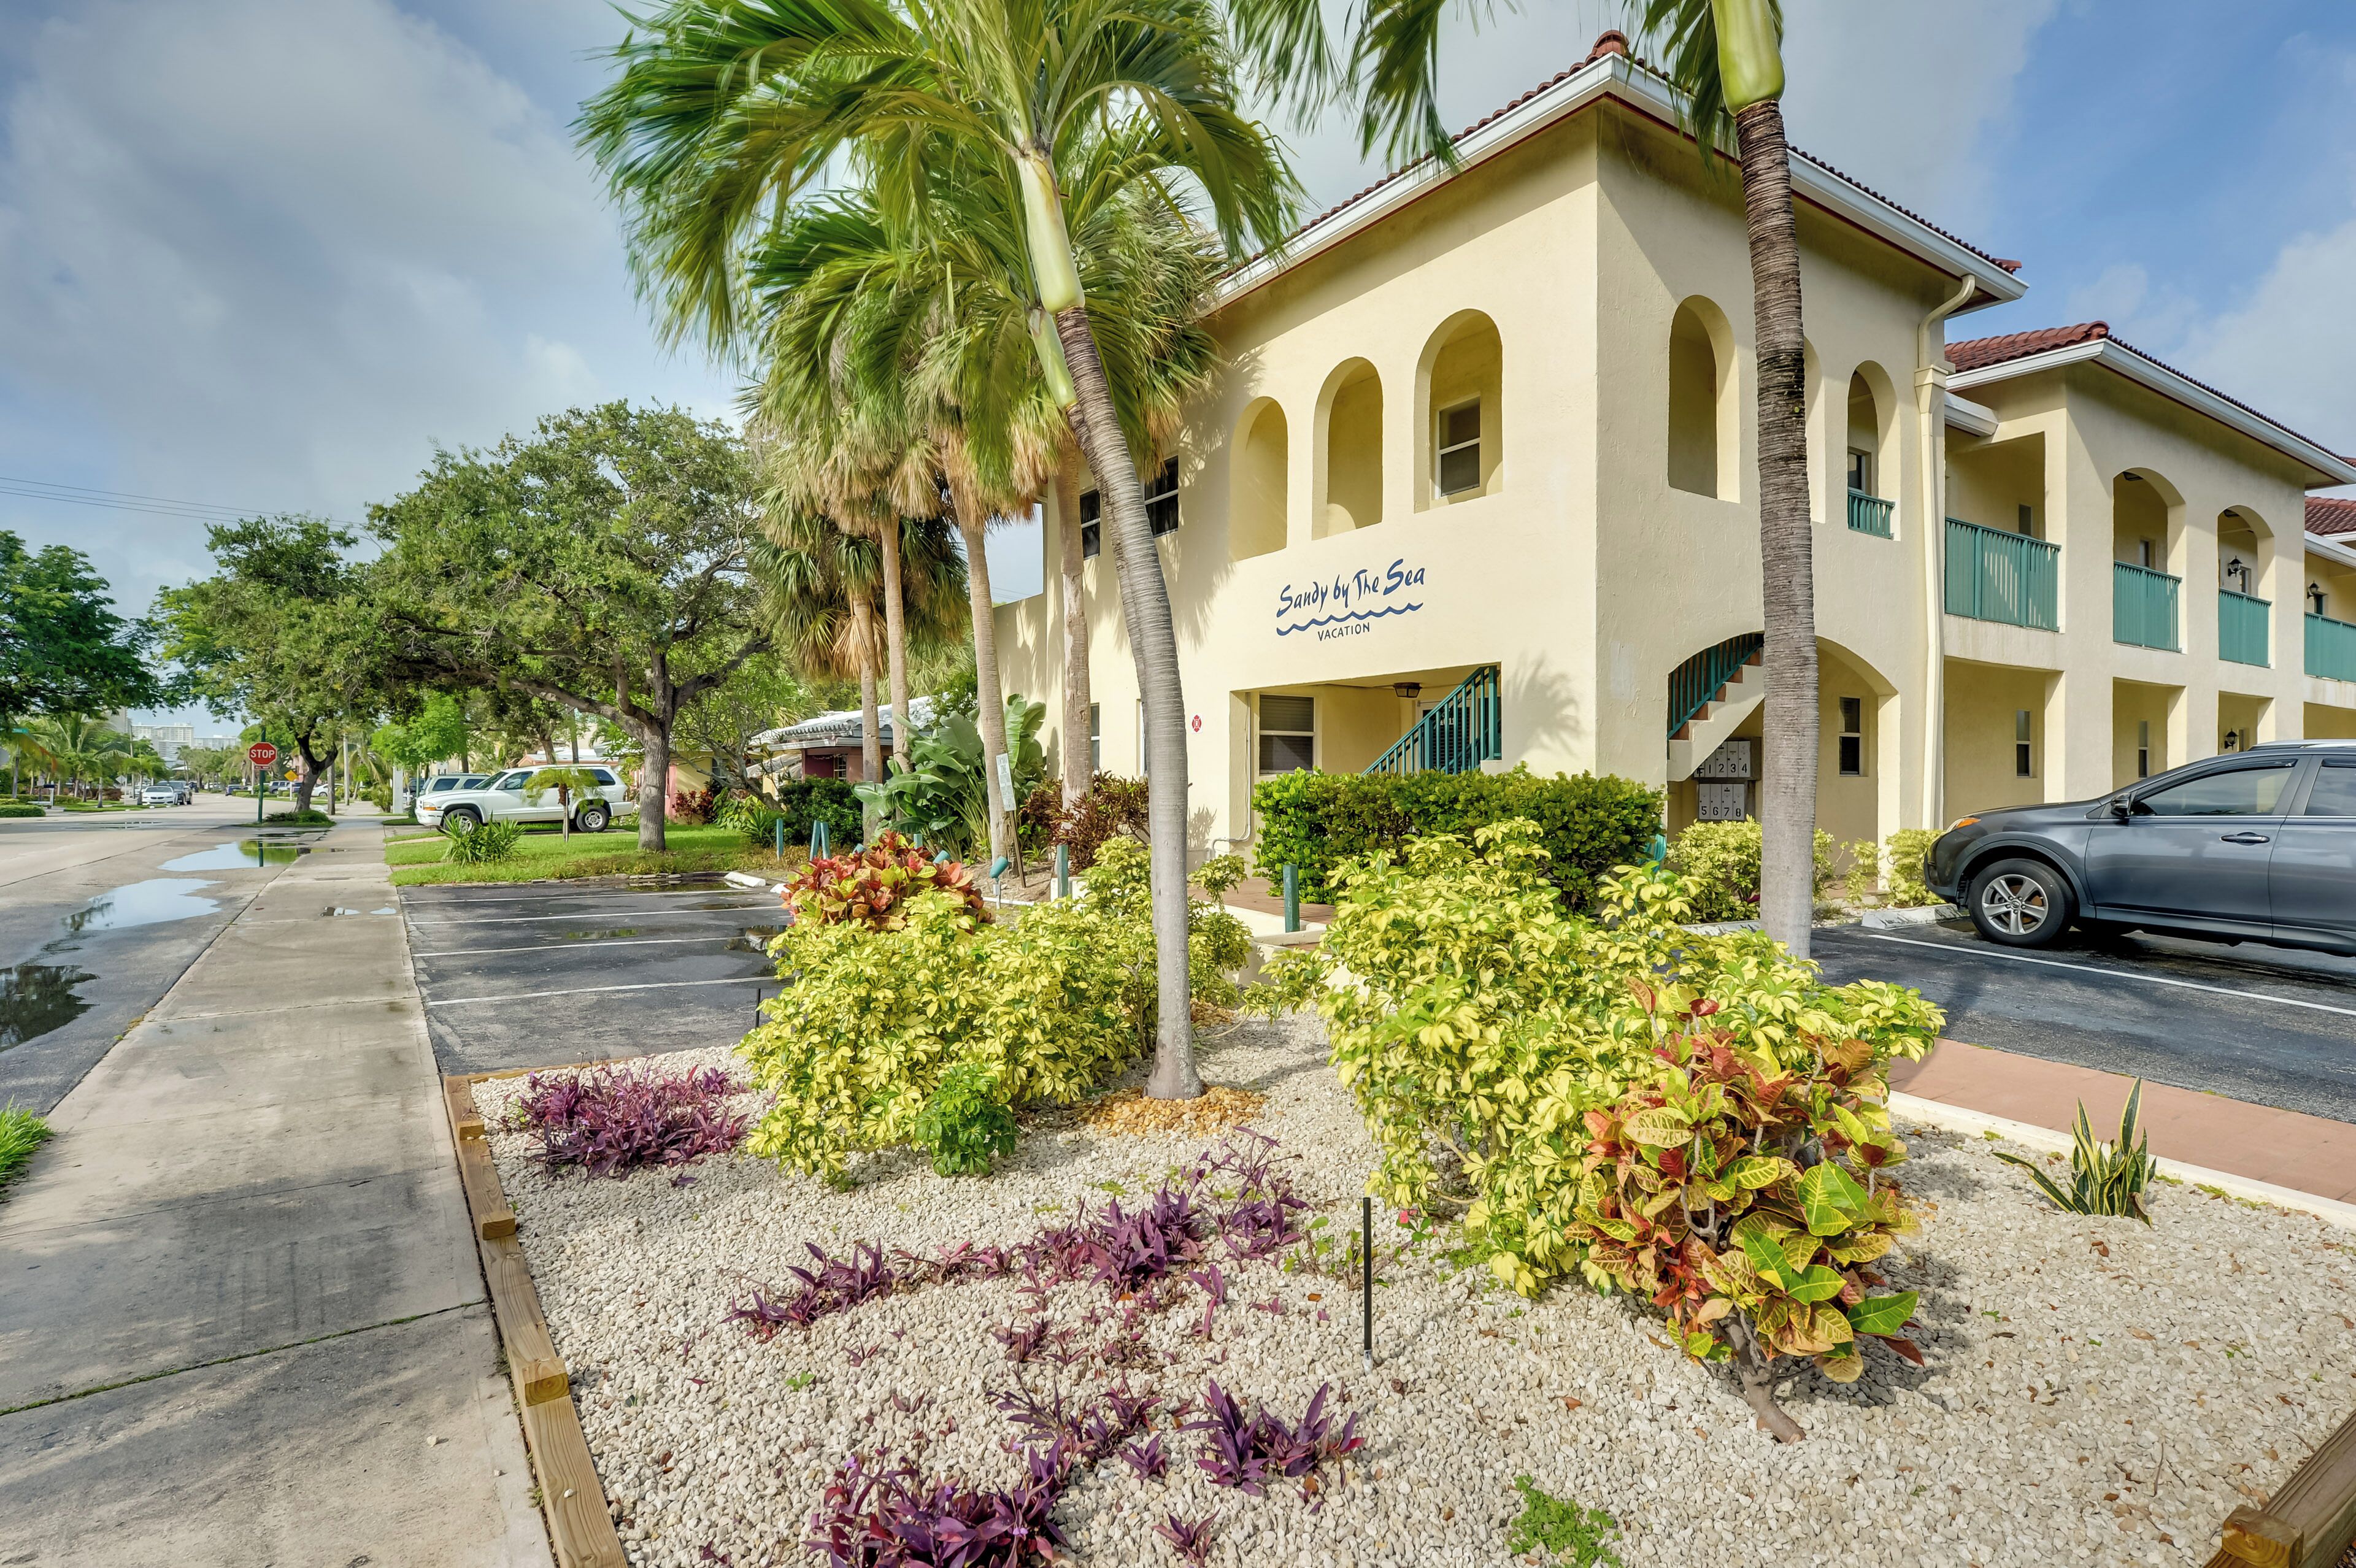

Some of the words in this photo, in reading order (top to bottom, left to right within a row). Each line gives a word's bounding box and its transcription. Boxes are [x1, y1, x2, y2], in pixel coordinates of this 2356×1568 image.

[1276, 581, 1328, 618] Sandy
[1333, 574, 1349, 609] by
[1352, 569, 1379, 601] The
[1383, 558, 1425, 596] Sea
[1317, 622, 1370, 642] VACATION
[250, 749, 275, 758] STOP
[1709, 764, 1711, 774] 1
[1719, 763, 1724, 773] 2
[1730, 763, 1736, 773] 3
[1741, 763, 1747, 773] 4
[1701, 805, 1707, 815] 5
[1712, 807, 1719, 816] 6
[1724, 807, 1730, 817] 7
[1736, 808, 1741, 817] 8
